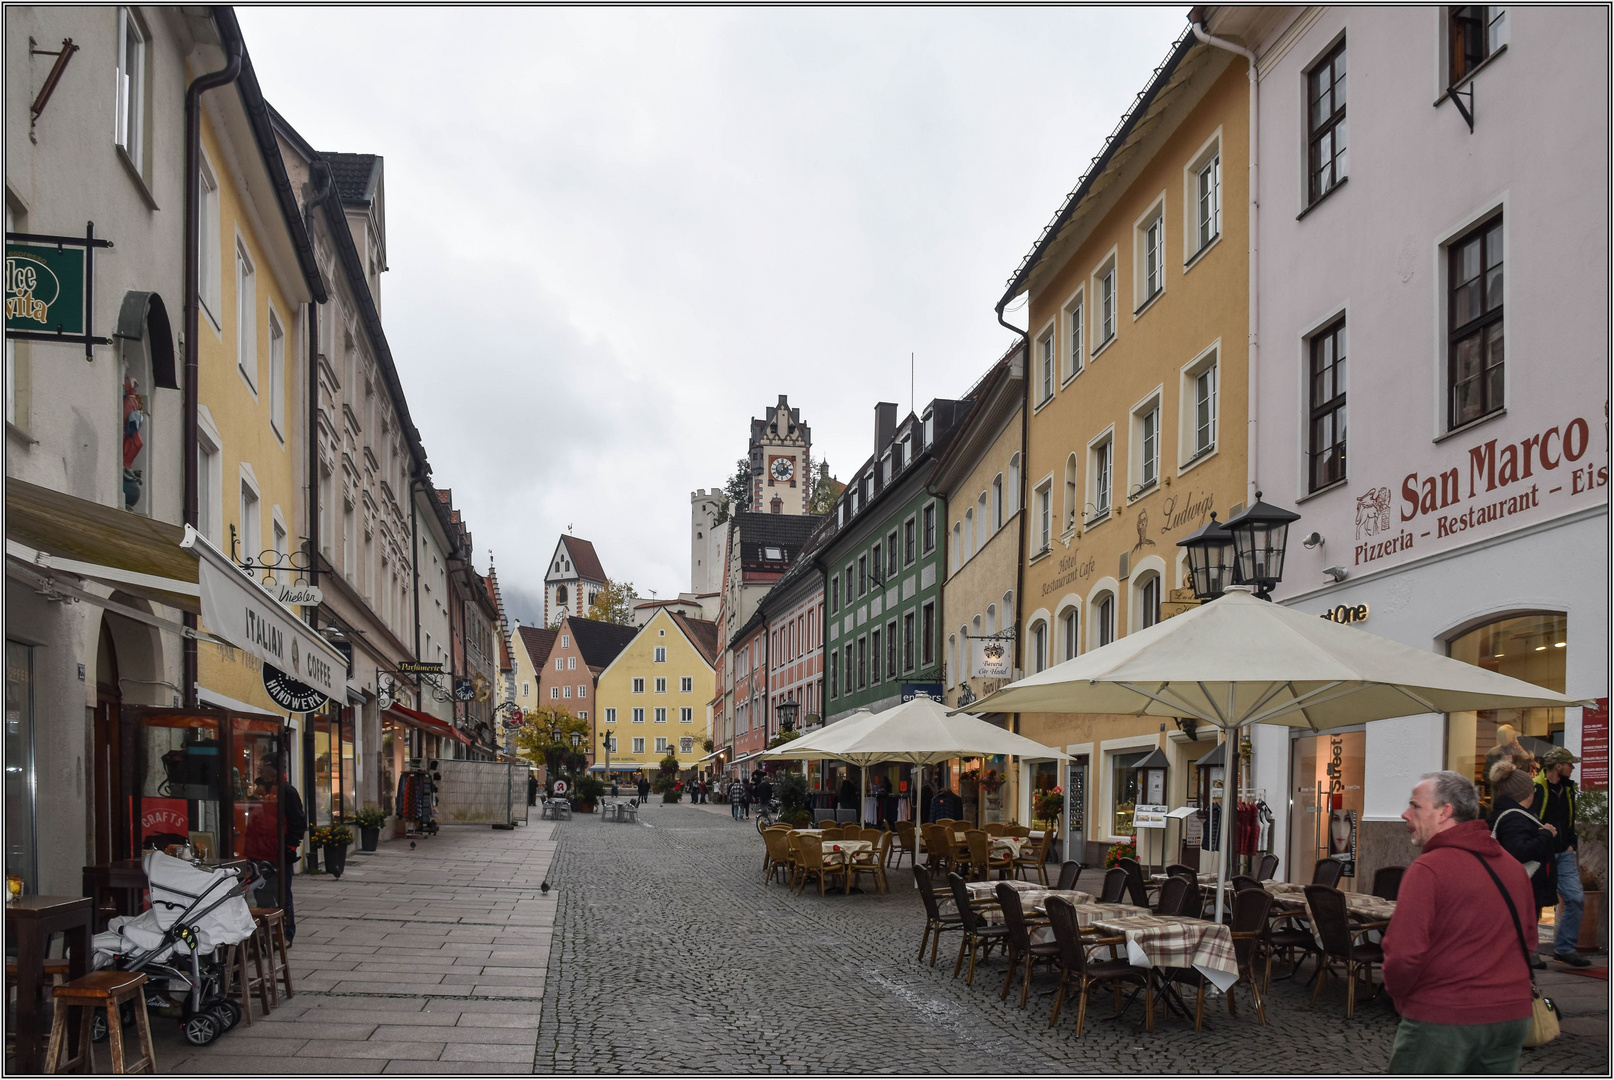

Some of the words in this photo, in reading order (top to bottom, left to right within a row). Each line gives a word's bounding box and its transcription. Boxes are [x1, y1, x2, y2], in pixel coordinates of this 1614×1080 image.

[6, 260, 37, 292] lce
[1400, 466, 1460, 523] San
[1468, 417, 1589, 499] Marco
[1161, 491, 1214, 534] Ludwigs
[1355, 529, 1414, 566] Pizzeria
[1437, 483, 1540, 539] Restaurant
[1058, 549, 1079, 575] Hotel
[1042, 568, 1078, 597] Restaurant
[246, 607, 284, 660] ITALIAN
[307, 652, 331, 689] COFFEE
[266, 679, 323, 710] HANDWERK
[141, 812, 184, 828] CRAFTS
